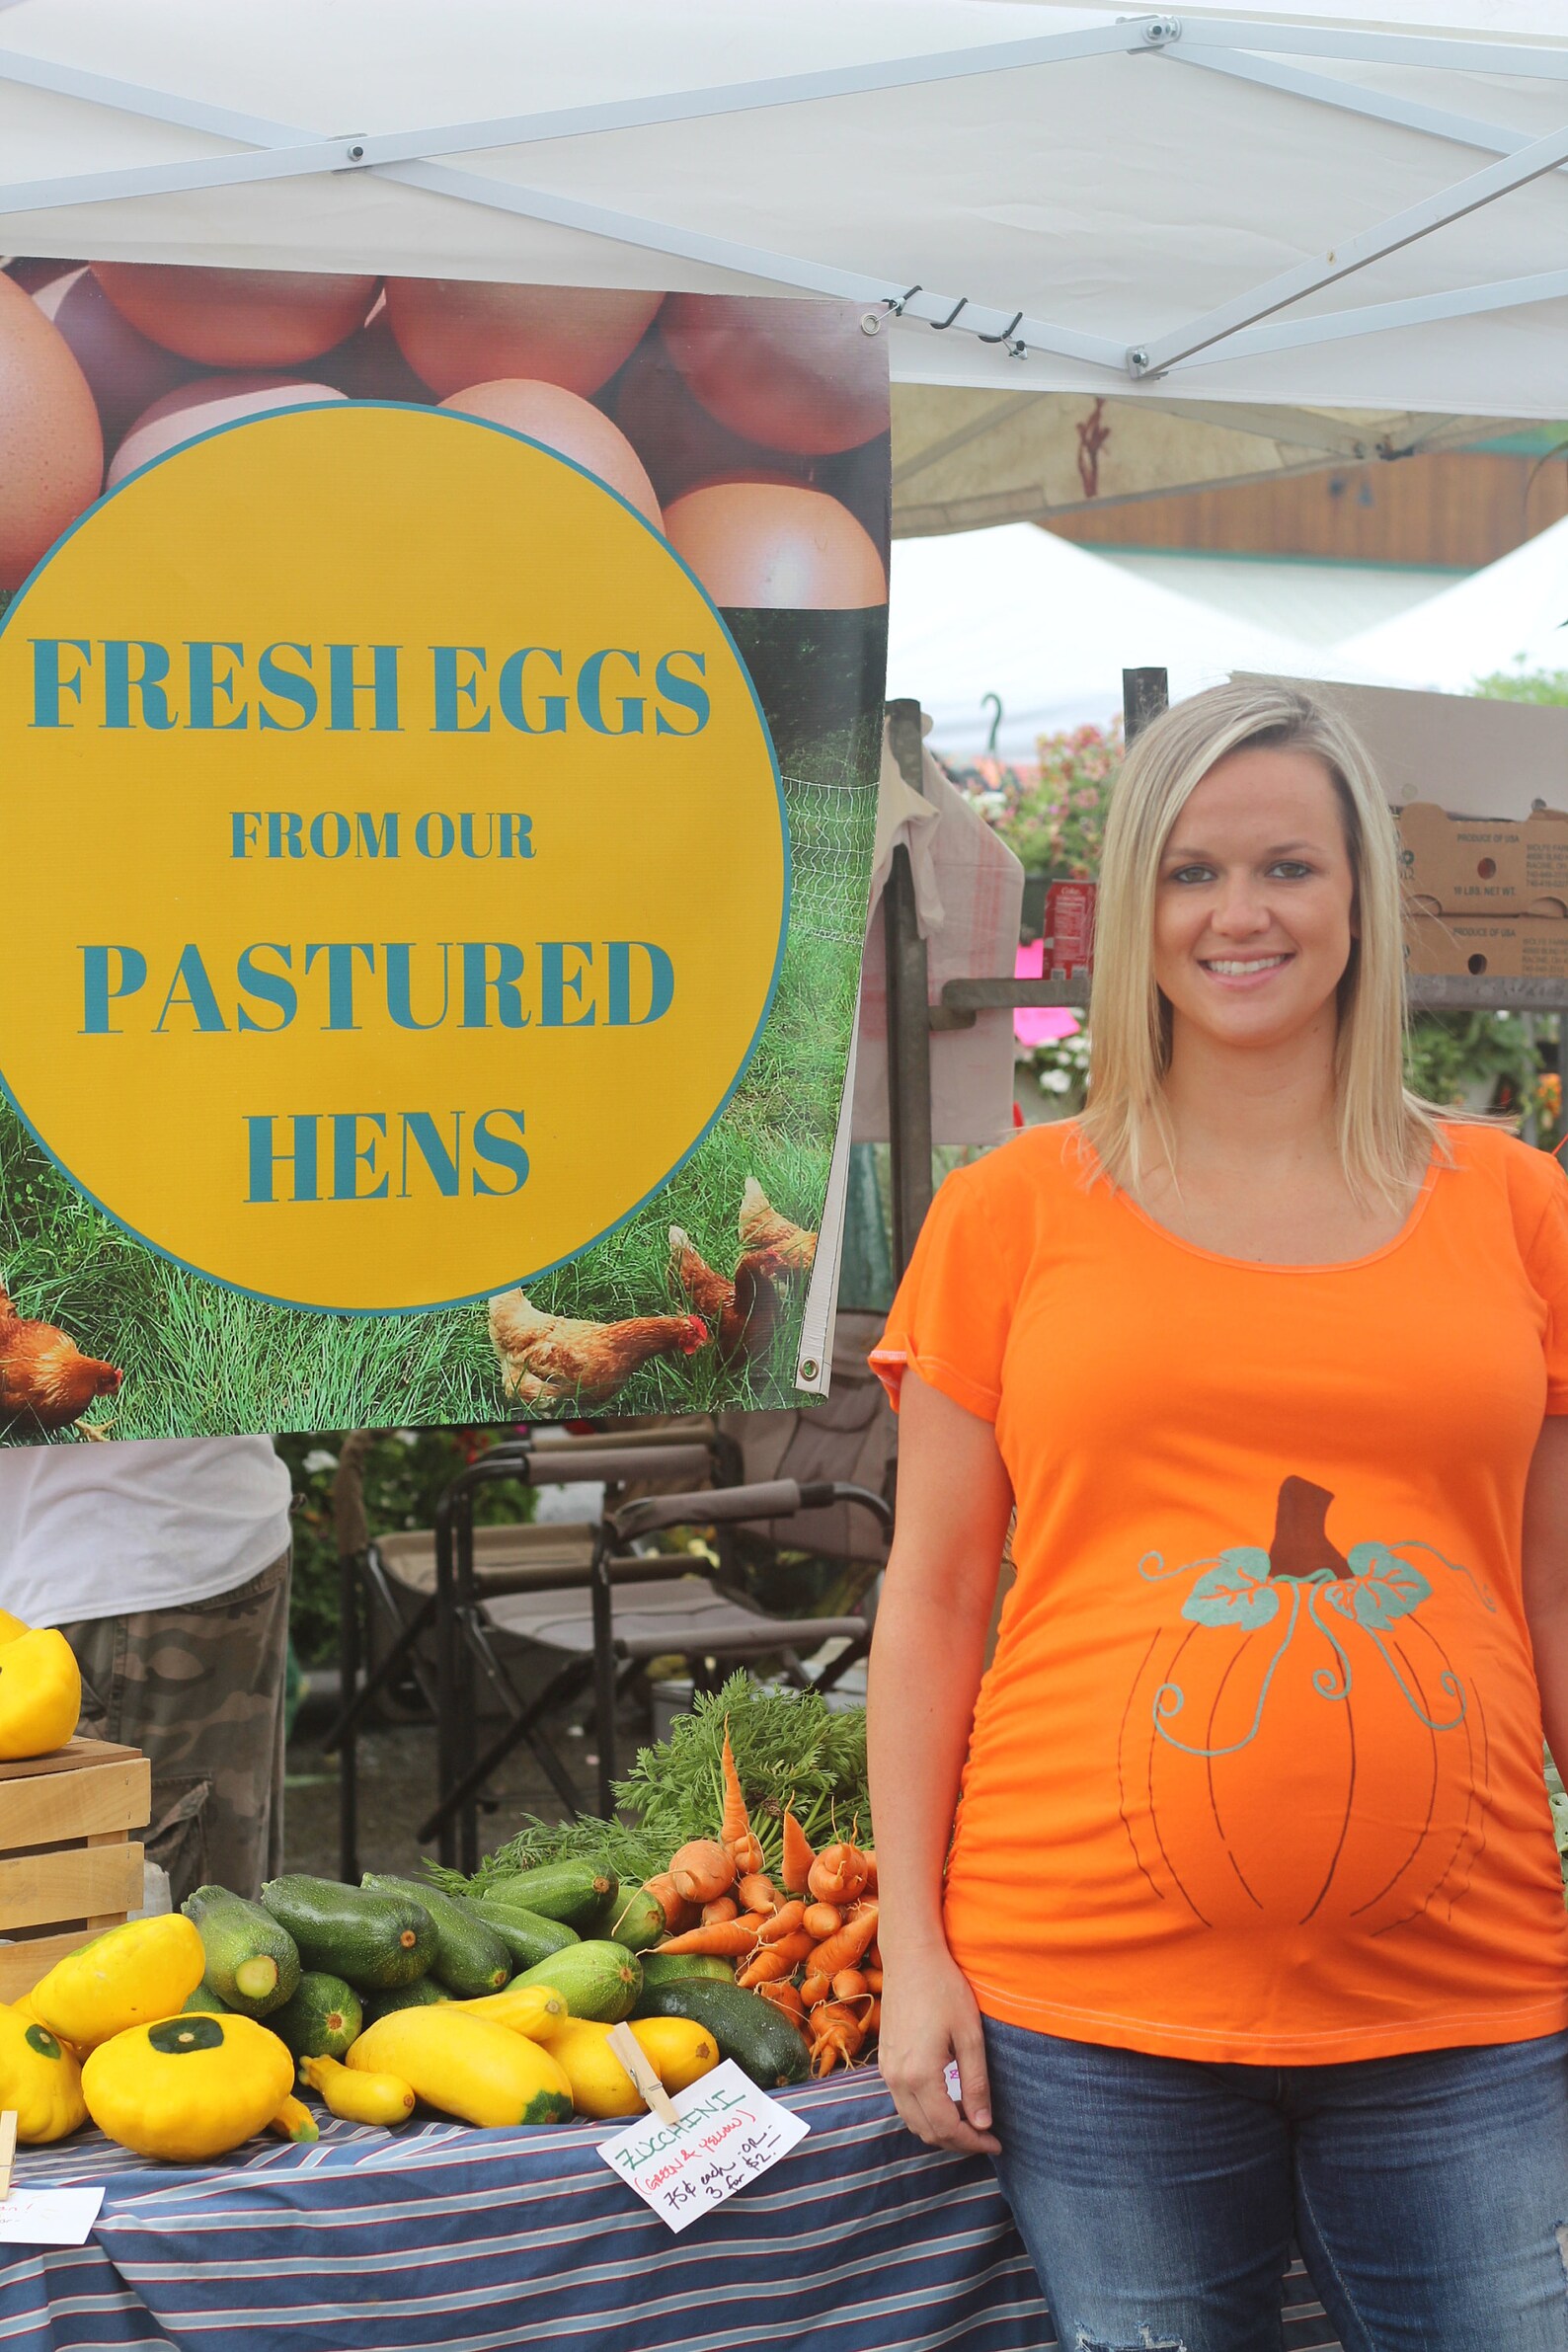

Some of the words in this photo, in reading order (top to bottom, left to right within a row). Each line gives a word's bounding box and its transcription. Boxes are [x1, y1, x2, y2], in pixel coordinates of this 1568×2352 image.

[28, 639, 404, 731] FRESH
[429, 647, 710, 736] EGGS
[231, 812, 400, 858] FROM
[416, 813, 536, 858] OUR
[1456, 833, 1492, 843] PRODUCE
[1493, 834, 1503, 843] OF
[1484, 886, 1500, 897] NET
[1452, 927, 1487, 937] PRODUCE
[1489, 928, 1500, 937] OF
[1501, 928, 1517, 937] USA
[77, 942, 674, 1033] PASTURED
[243, 1109, 529, 1203] HENS
[614, 2089, 746, 2171] ZUCCHINI
[700, 2161, 737, 2186] each
[705, 2185, 724, 2200] 3
[725, 2173, 746, 2192] for
